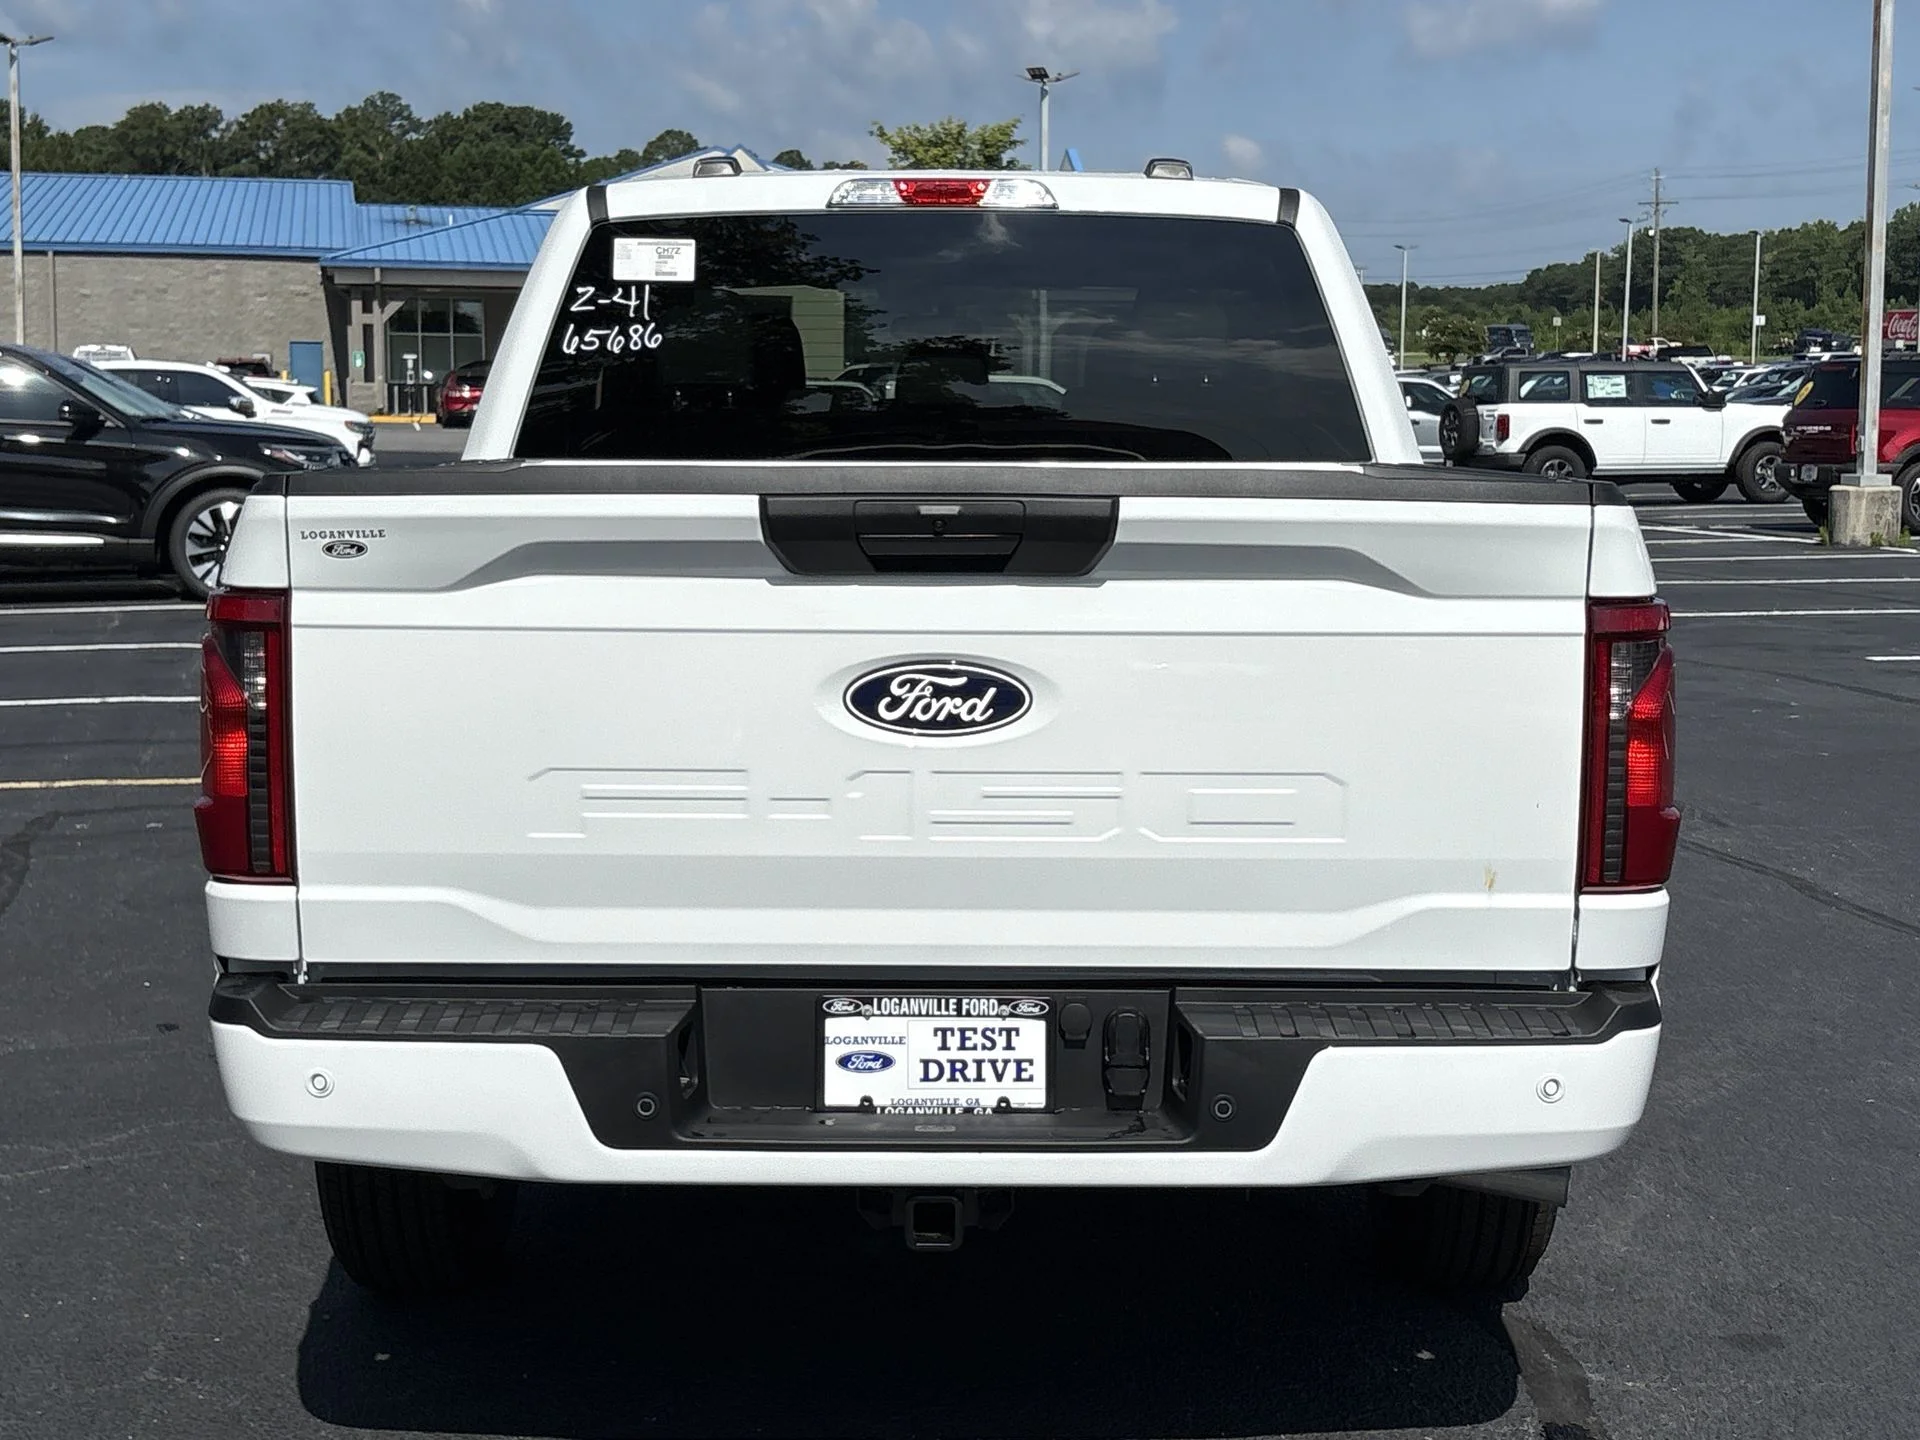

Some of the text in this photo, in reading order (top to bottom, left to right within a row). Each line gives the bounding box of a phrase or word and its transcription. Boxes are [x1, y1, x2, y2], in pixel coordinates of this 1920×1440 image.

[562, 322, 662, 354] 65686
[300, 529, 386, 539] LOGANVILLE
[331, 544, 358, 555] Ford
[877, 673, 997, 722] Ford
[527, 767, 1347, 846] F-150
[873, 998, 957, 1016] LOGANVILLE
[962, 998, 998, 1016] FORD
[825, 1036, 906, 1045] LOGANVILLE
[933, 1027, 1020, 1051] TEST
[847, 1054, 883, 1070] Ford
[919, 1058, 1034, 1082] DRIVE
[965, 1098, 980, 1106] GA
